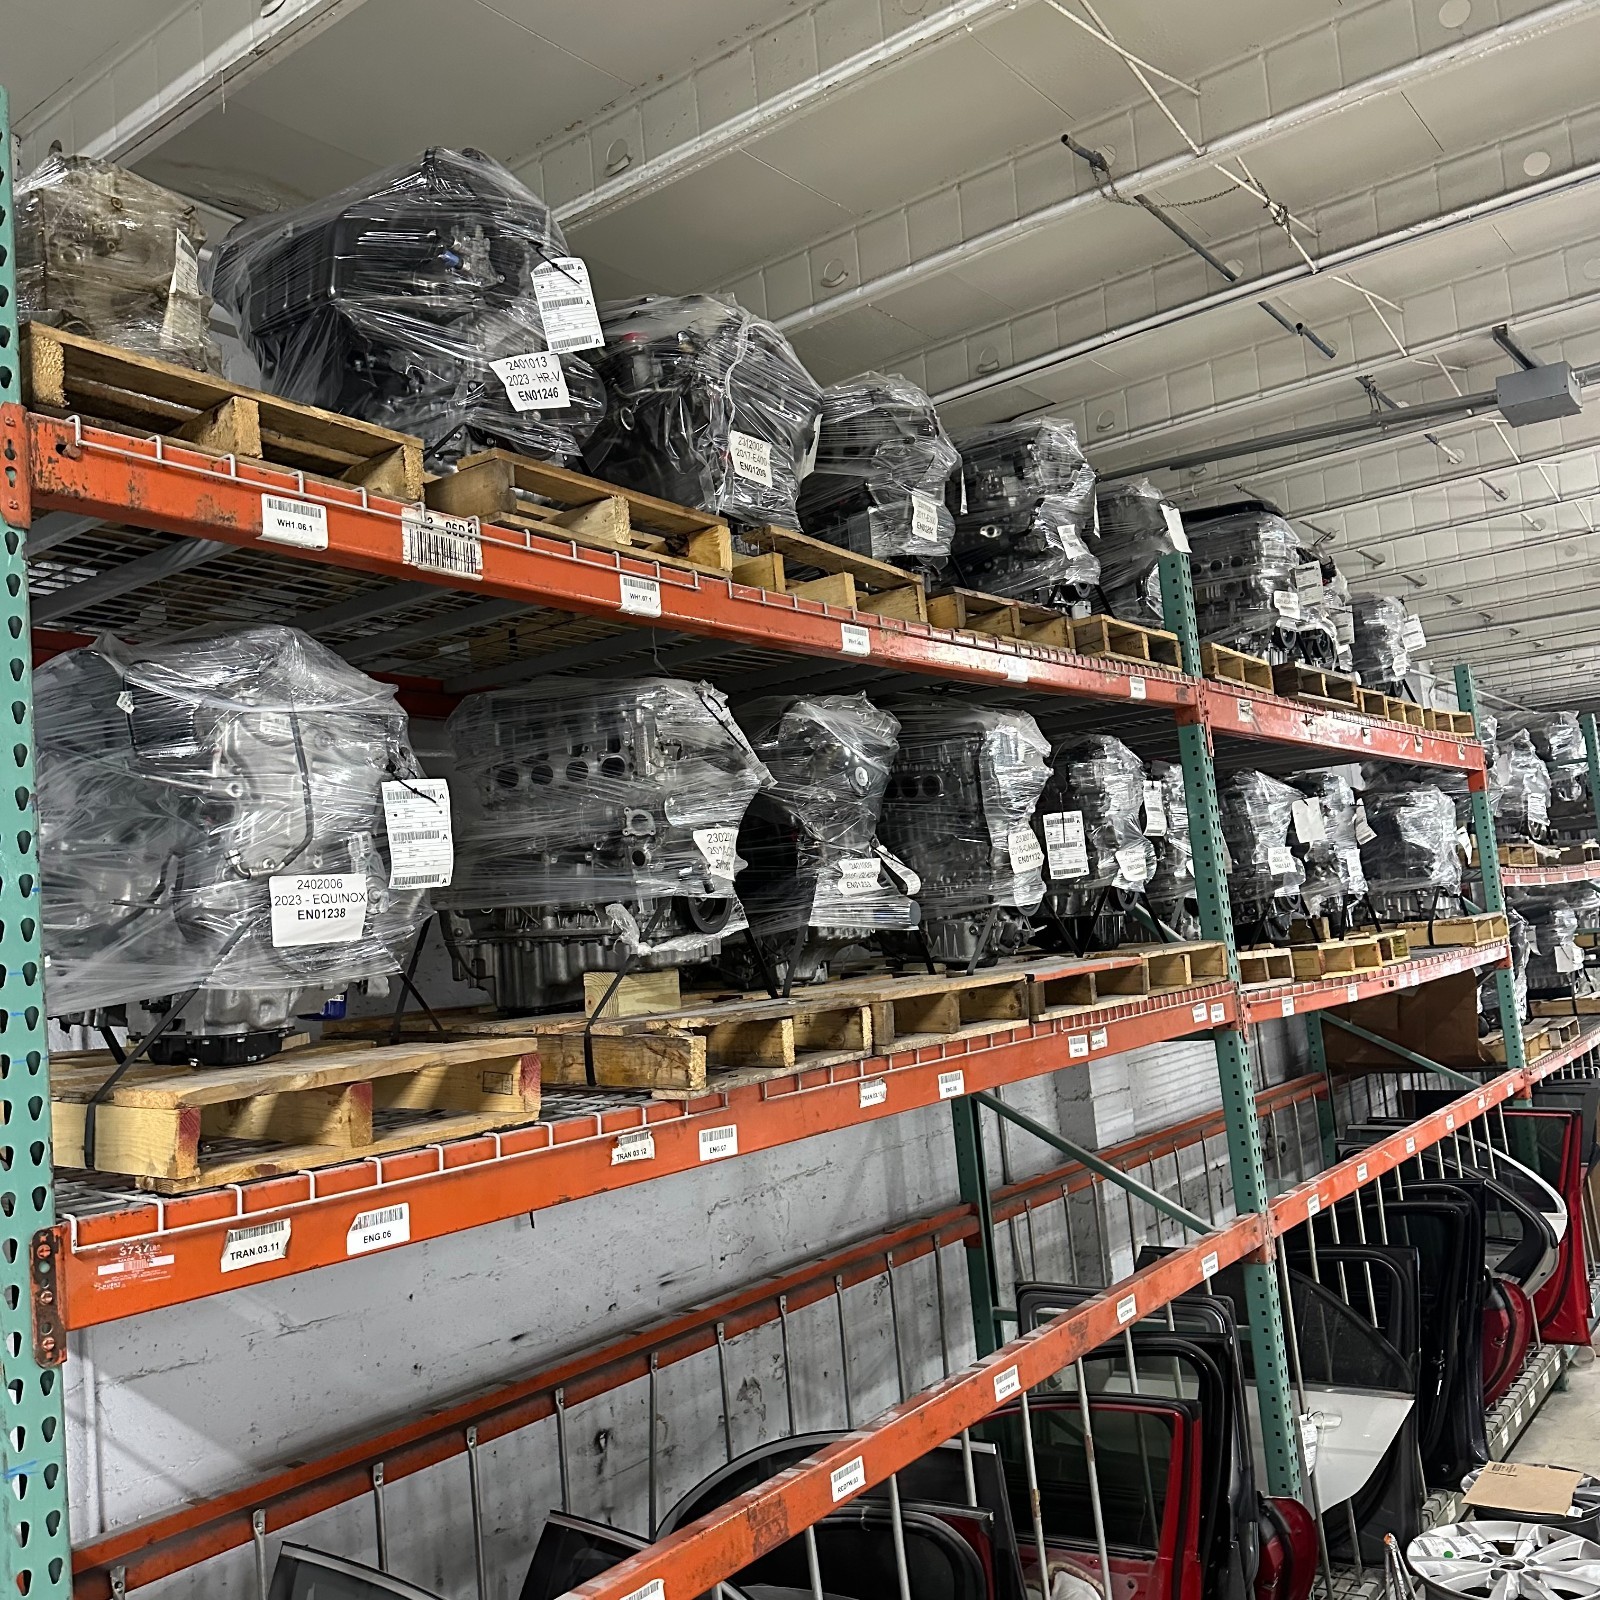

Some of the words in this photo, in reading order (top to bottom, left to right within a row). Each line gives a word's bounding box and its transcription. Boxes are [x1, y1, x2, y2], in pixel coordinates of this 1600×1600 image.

[505, 356, 548, 371] 2401013
[505, 373, 530, 387] 2023
[537, 371, 561, 384] HR-V
[517, 386, 559, 402] EN01246
[276, 518, 313, 533] WH1.06.1
[296, 878, 343, 890] 2402006
[274, 894, 302, 906] 2023
[312, 892, 366, 905] EQUINOX
[297, 907, 346, 921] EN01238
[362, 1229, 392, 1244] ENG.06
[229, 1241, 280, 1261] TRAN.03.11
